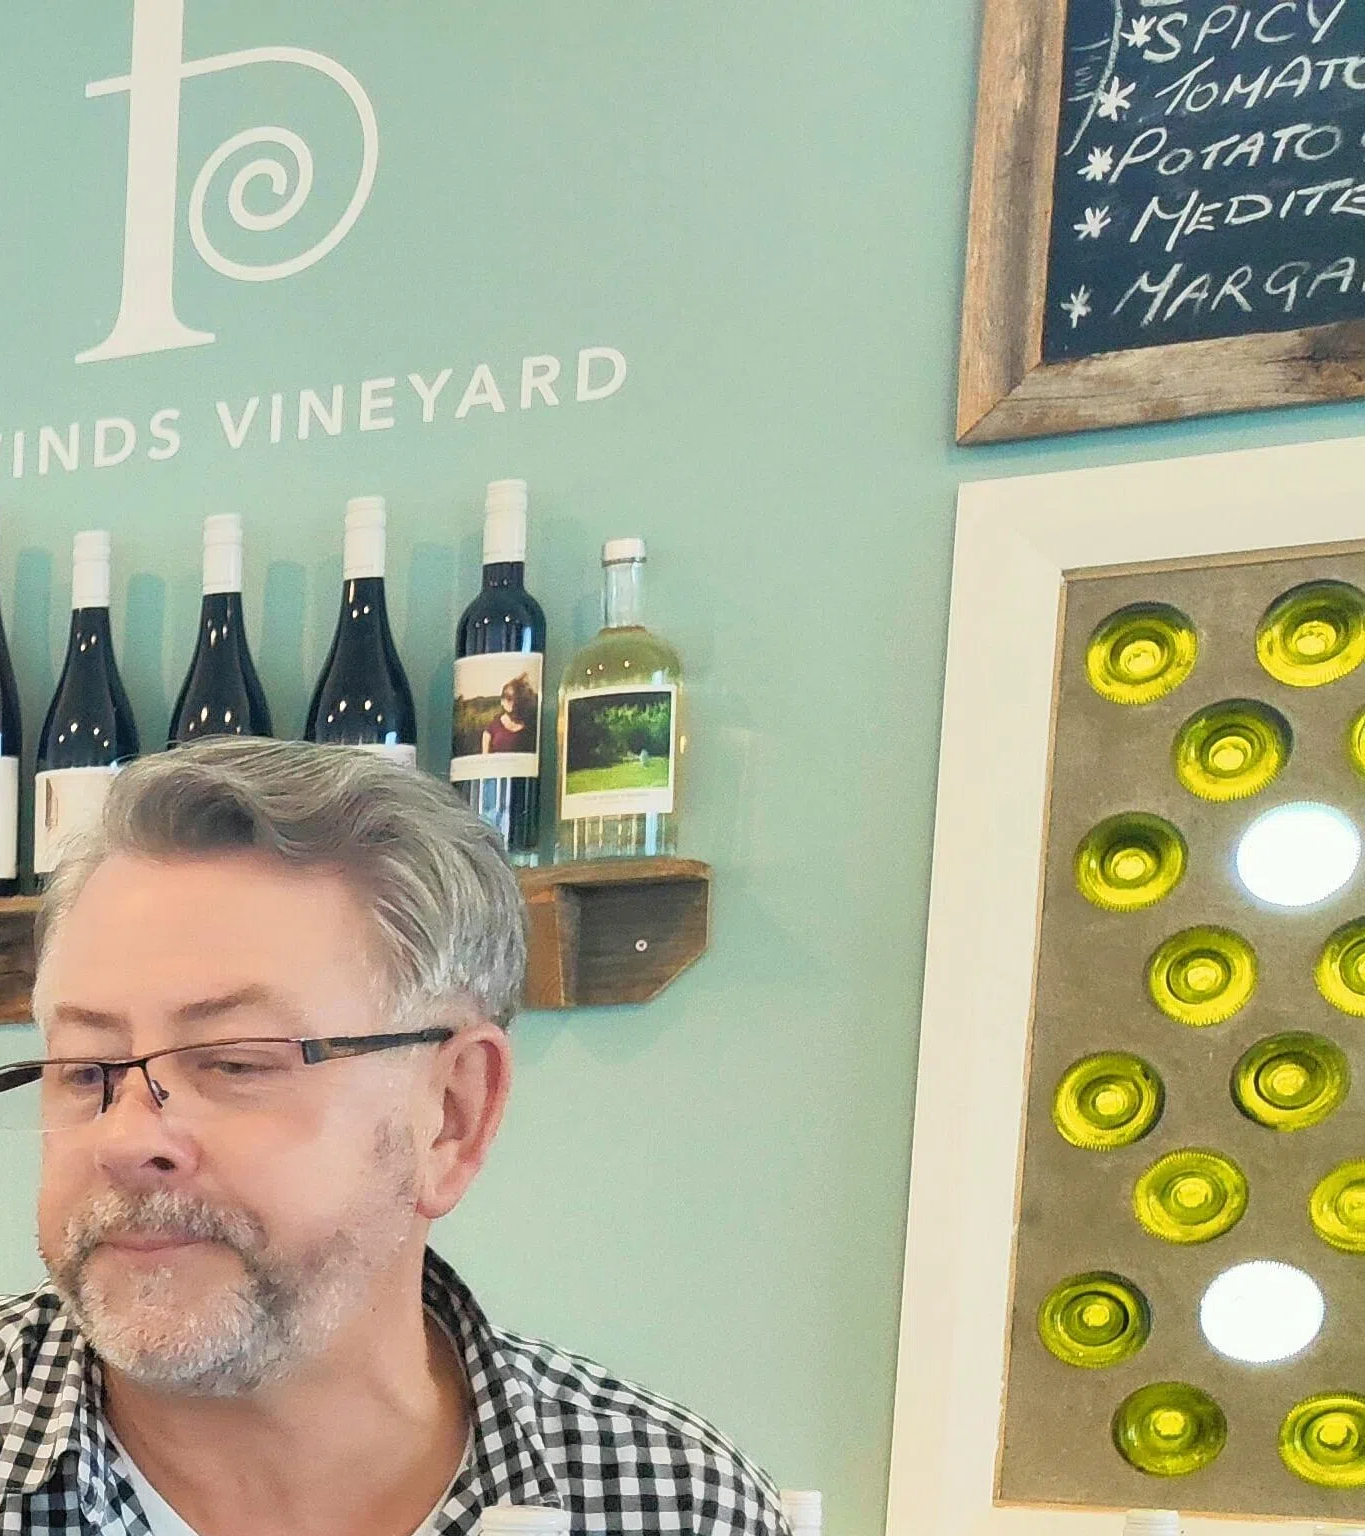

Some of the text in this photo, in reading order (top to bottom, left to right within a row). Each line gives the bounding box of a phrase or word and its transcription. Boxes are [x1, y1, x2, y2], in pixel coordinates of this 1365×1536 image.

[1143, 0, 1345, 63] SPICY
[1108, 123, 1343, 184] POTATO
[1113, 257, 1365, 326] MARGA
[216, 346, 627, 449] VINEYARD
